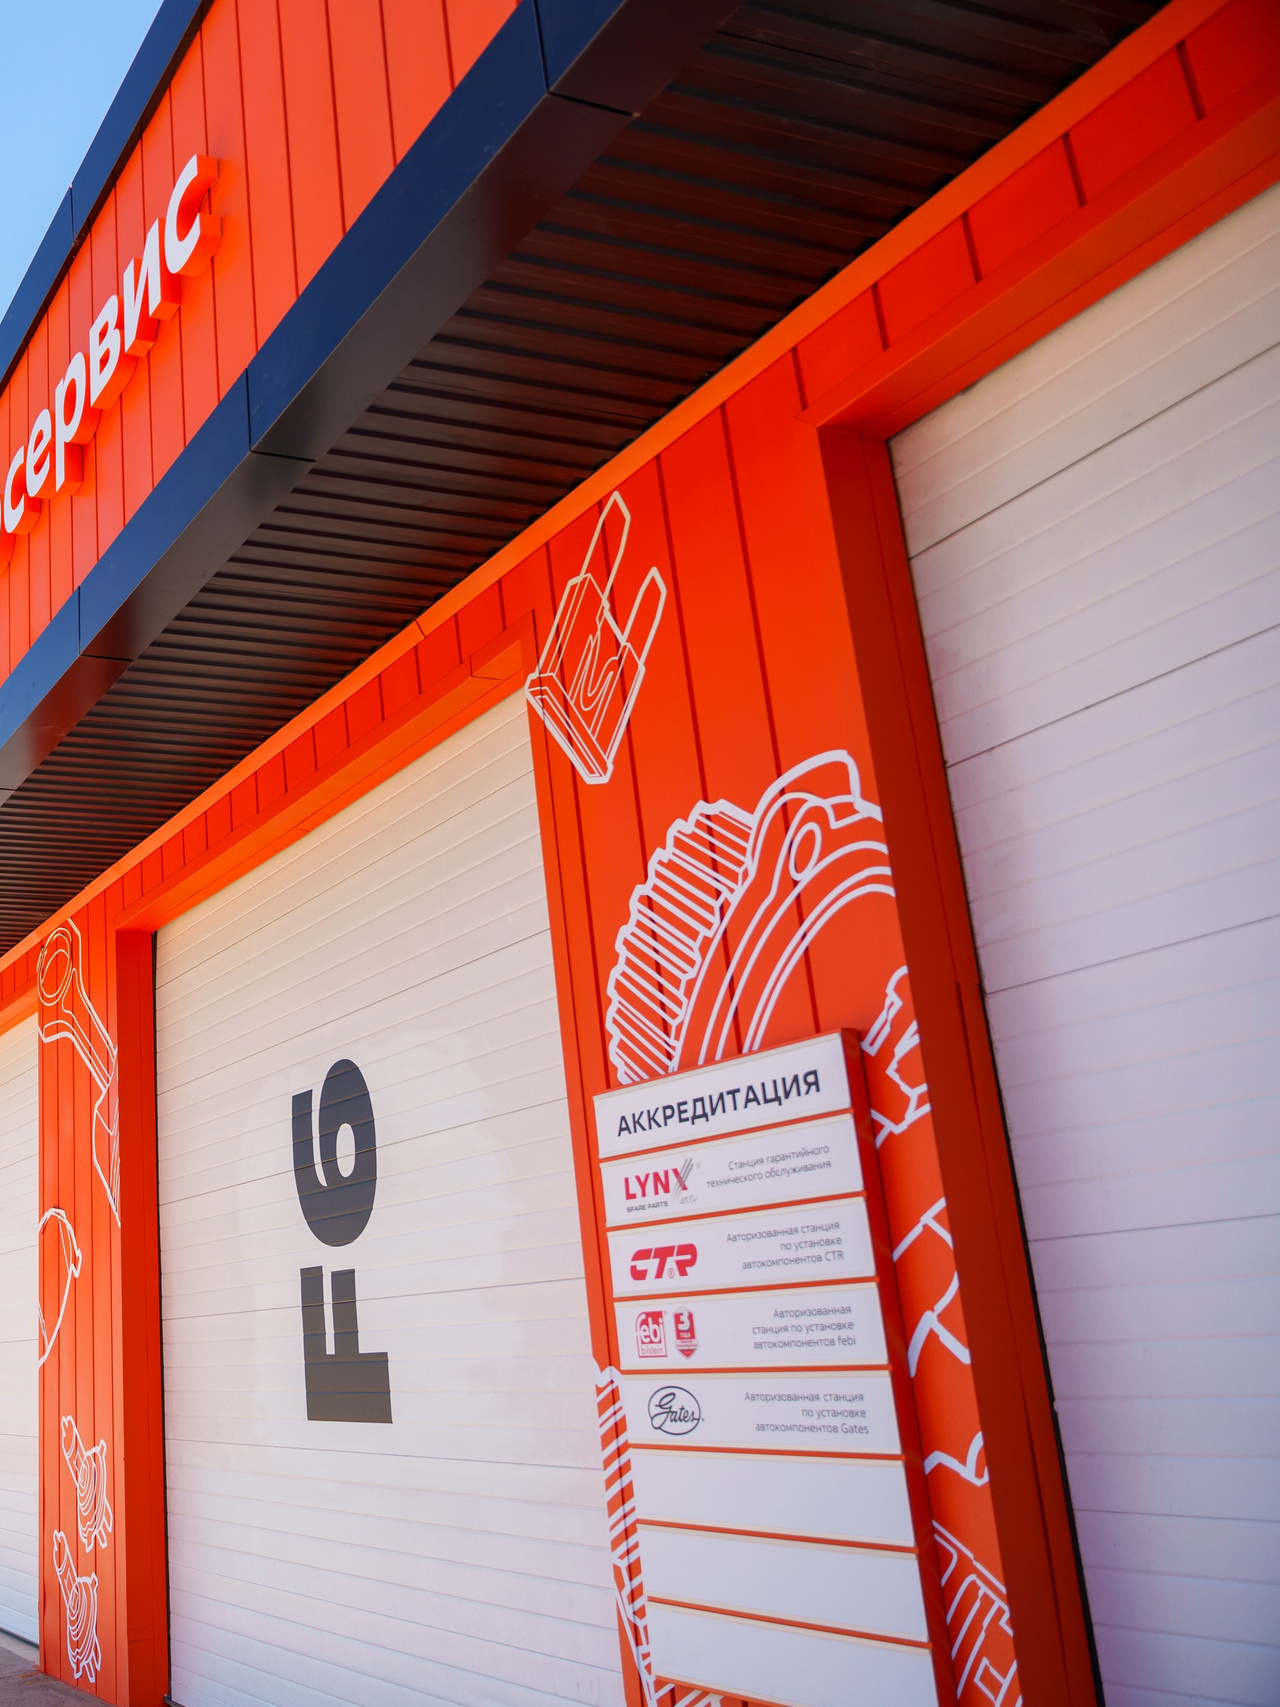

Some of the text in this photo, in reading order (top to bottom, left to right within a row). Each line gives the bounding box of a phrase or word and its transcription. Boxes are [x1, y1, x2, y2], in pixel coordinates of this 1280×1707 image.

[617, 1069, 821, 1137] АККРЕДИТАЦИЯ
[728, 1145, 830, 1171] Станция гарантийного
[624, 1160, 692, 1200] LYNX
[706, 1160, 832, 1188] технического обслуживания
[726, 1221, 840, 1242] Авторизованная станция
[780, 1236, 842, 1252] по установке
[630, 1242, 698, 1281] CTR
[742, 1250, 844, 1270] автокомпонентов CTR
[773, 1306, 852, 1319] Авторизованная
[636, 1313, 664, 1343] febi
[752, 1321, 854, 1335] станция по установке
[753, 1335, 856, 1349] автокомпонентов febi
[744, 1392, 864, 1403] Авторизованная станция
[651, 1391, 700, 1430] Gates
[801, 1408, 867, 1419] по установке
[755, 1423, 869, 1434] автокомпонентов Gates
